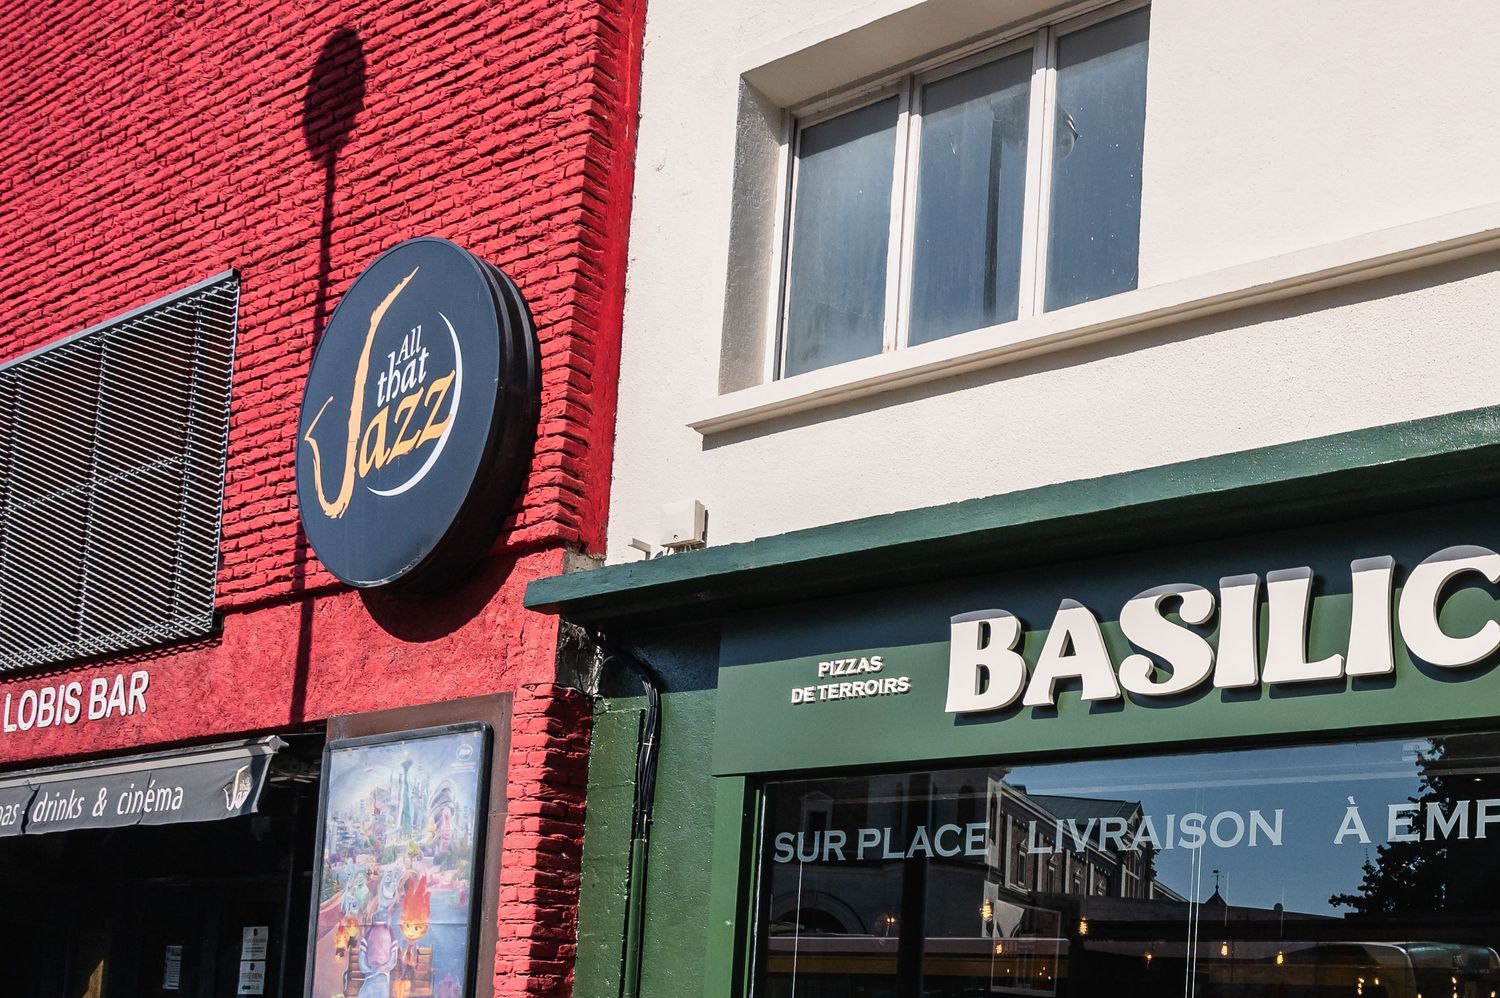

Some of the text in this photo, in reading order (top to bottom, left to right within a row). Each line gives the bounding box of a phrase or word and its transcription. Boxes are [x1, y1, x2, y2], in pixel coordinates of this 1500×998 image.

[395, 325, 422, 365] All
[304, 266, 455, 519] Jazz
[377, 347, 429, 408] that
[818, 656, 884, 678] PIZZAS
[3, 670, 150, 733] LOBIS BAR
[791, 677, 912, 704] DE TERROIRS
[33, 789, 85, 823] drinks
[92, 787, 107, 817] &
[117, 779, 184, 816] cinéma
[1333, 795, 1372, 845] À
[773, 821, 990, 863] SUR PLACE
[1026, 807, 1285, 855] LIVRAISON
